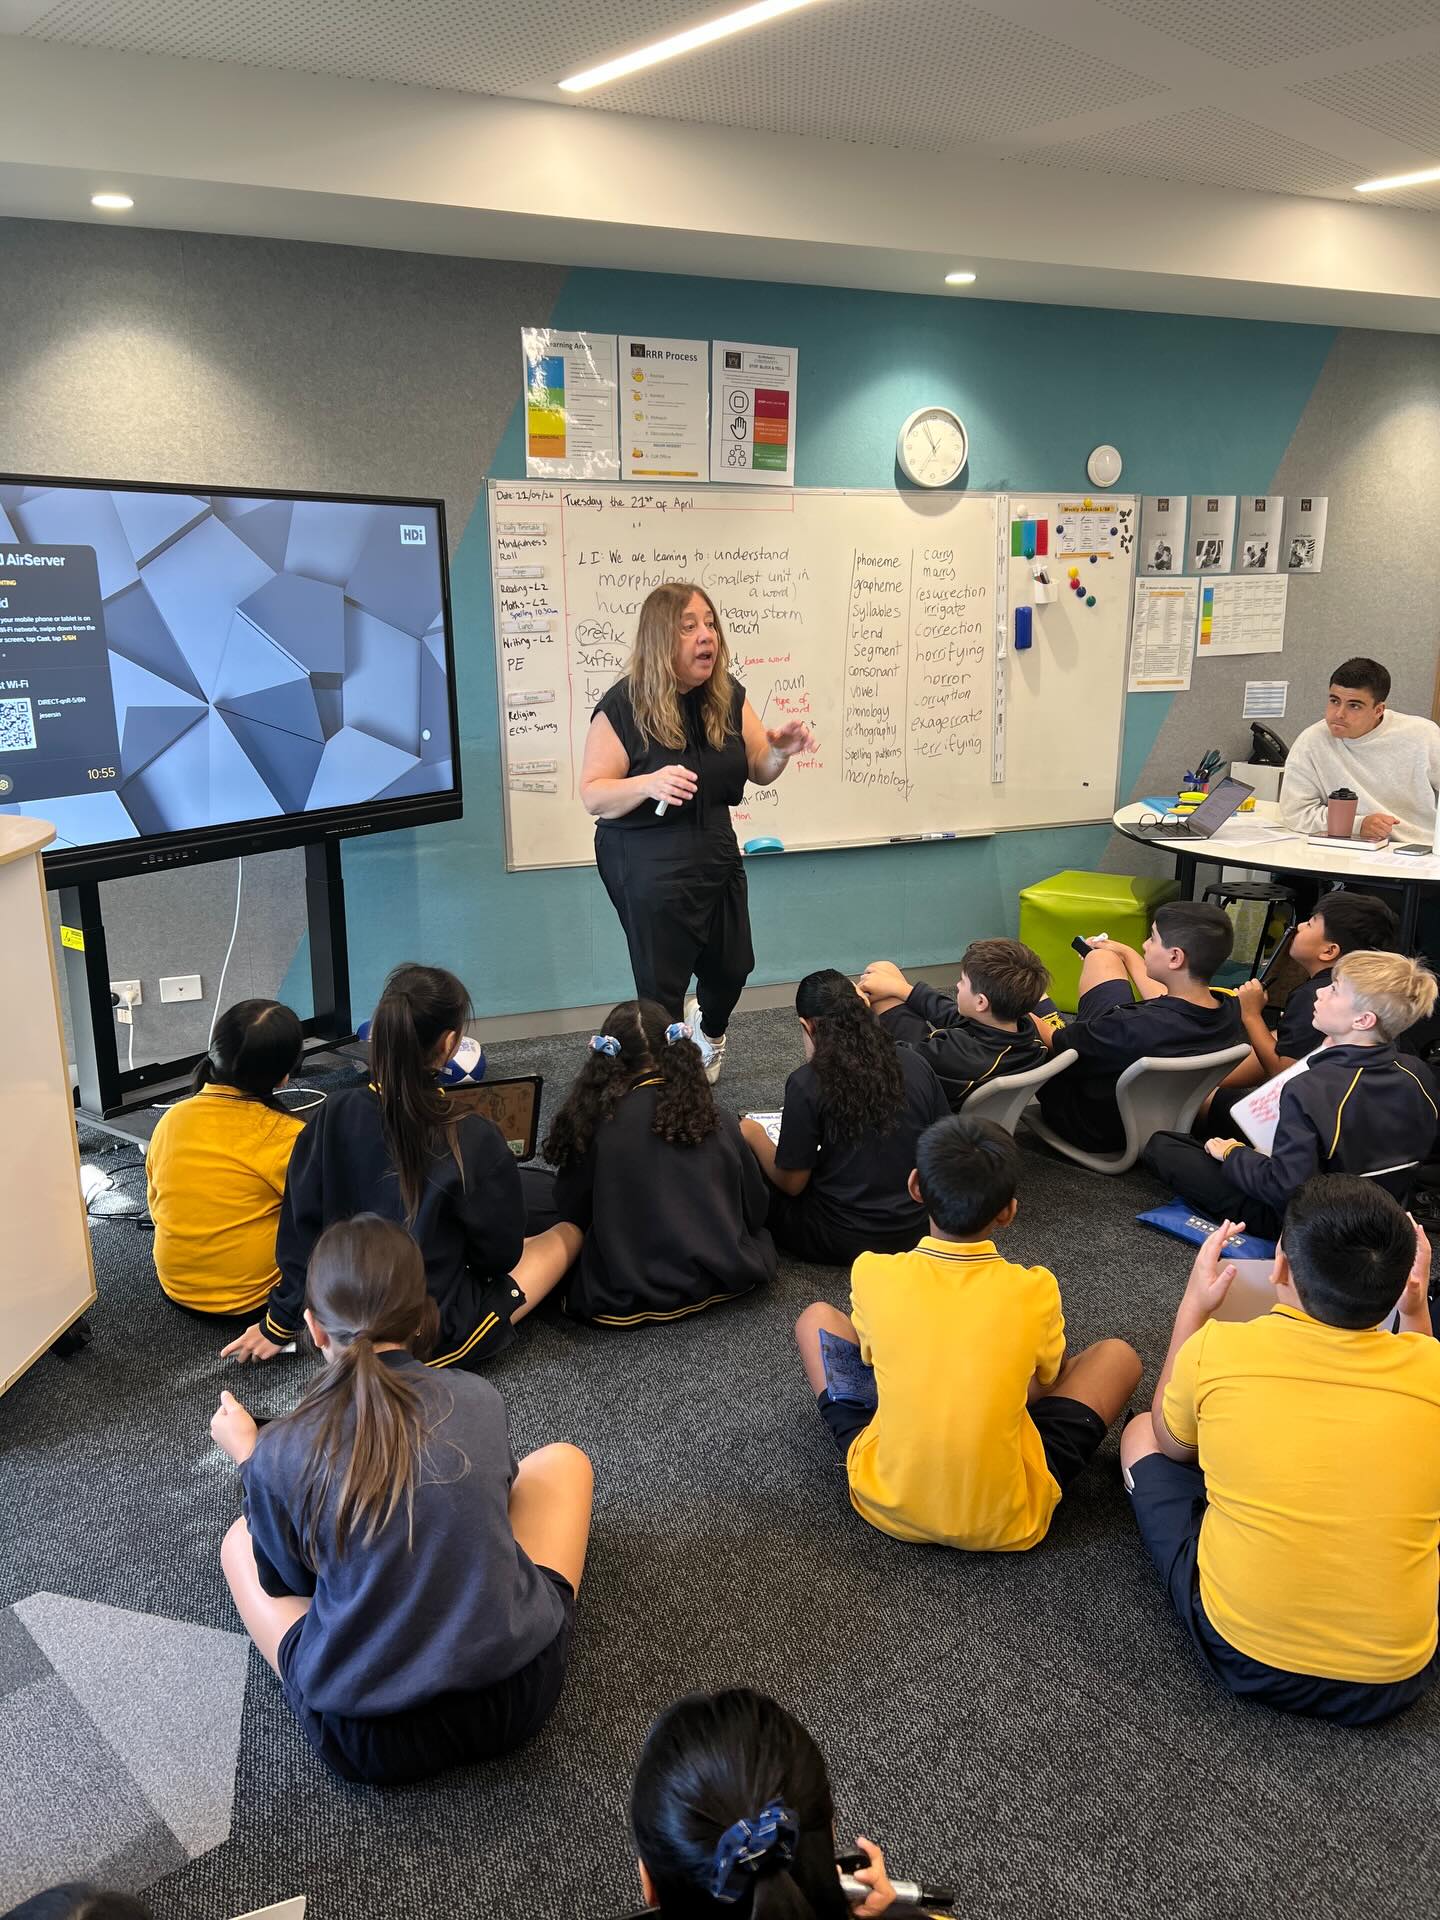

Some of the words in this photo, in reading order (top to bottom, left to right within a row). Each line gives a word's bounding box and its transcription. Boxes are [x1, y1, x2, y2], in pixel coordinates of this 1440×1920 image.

[646, 350, 663, 360] RRR
[666, 352, 698, 361] Process
[564, 494, 602, 512] Tuesday
[610, 497, 624, 506] the
[632, 496, 653, 508] 21st
[656, 500, 667, 512] of
[674, 497, 694, 512] April
[404, 529, 422, 540] HDi
[6, 554, 66, 566] AirServer
[500, 552, 518, 560] Roll
[610, 550, 623, 564] We
[632, 553, 646, 562] are
[653, 549, 687, 568] learning
[714, 546, 790, 561] understand
[857, 553, 902, 570] phoneme
[924, 549, 954, 564] carry
[768, 569, 791, 582] unit
[798, 568, 810, 580] in
[924, 567, 956, 580] marry
[748, 588, 758, 598] a
[854, 578, 904, 598] grapheme
[916, 586, 986, 600] resurrection
[510, 608, 532, 620] Spelling
[720, 600, 758, 623] heavy
[762, 604, 804, 624] storm
[924, 602, 966, 620] irrigate
[729, 622, 760, 634] noun
[915, 622, 982, 638] correction
[744, 656, 764, 665] base
[768, 652, 790, 663] word
[916, 641, 984, 666] horrifying
[508, 658, 525, 670] PE
[848, 664, 900, 678] consonant
[924, 665, 972, 686] horror
[6, 680, 29, 689] Wi-Fi
[774, 674, 805, 692] noun
[508, 710, 536, 722] Religion
[786, 704, 810, 714] word
[846, 704, 890, 724] phonology
[911, 708, 983, 732] exagerrate
[912, 734, 982, 757] terrifying
[796, 758, 824, 772] prefix
[88, 767, 116, 780] 10:55
